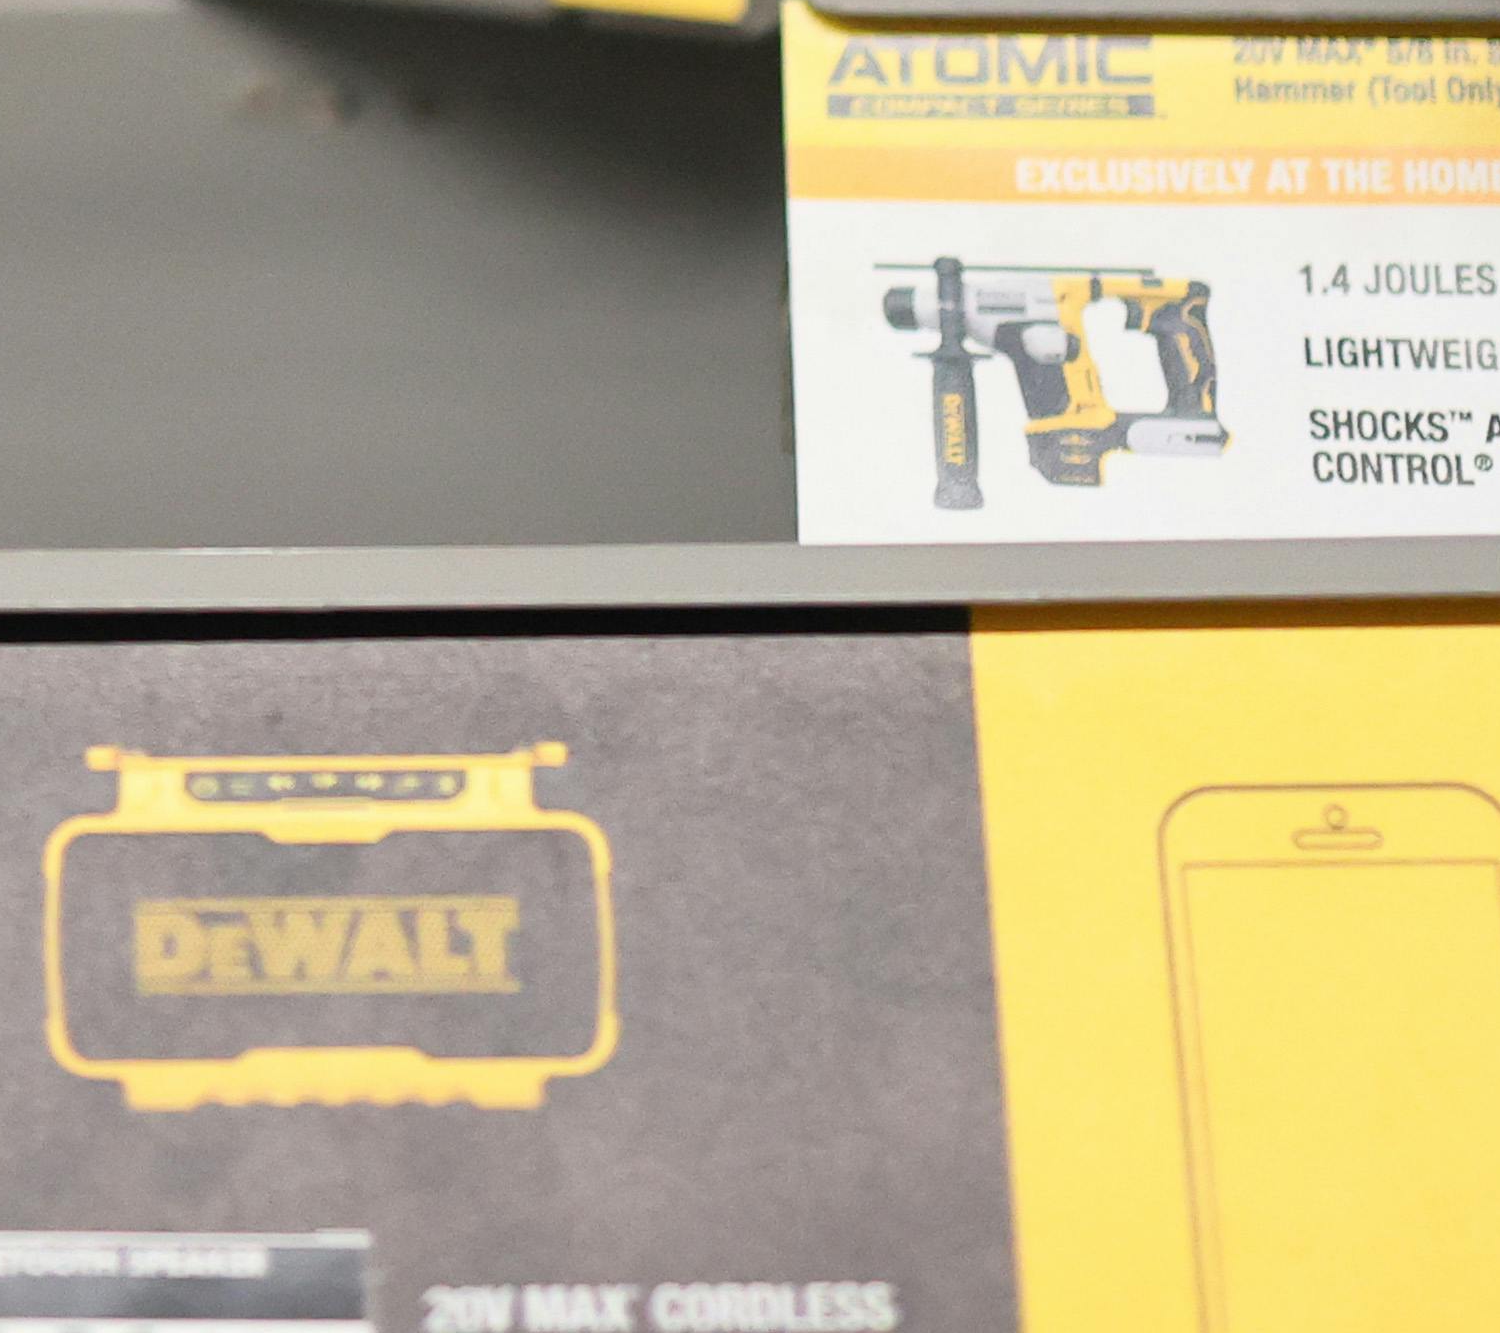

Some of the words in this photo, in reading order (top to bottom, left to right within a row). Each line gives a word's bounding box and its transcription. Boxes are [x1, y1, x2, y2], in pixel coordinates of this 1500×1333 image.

[828, 34, 1153, 85] ATOMIC
[1233, 36, 1287, 64] 20V
[1233, 76, 1356, 102] Hammer
[1368, 76, 1436, 107] (Tool
[1014, 157, 1254, 194] EXCLUSIVELY
[1266, 157, 1312, 193] AT
[1322, 157, 1391, 193] THE
[1298, 264, 1351, 296] 1.4
[1363, 264, 1498, 296] JOULES
[135, 904, 520, 986] DEWALT
[421, 1283, 515, 1332] 20V
[648, 1281, 898, 1332] CORDLESS
